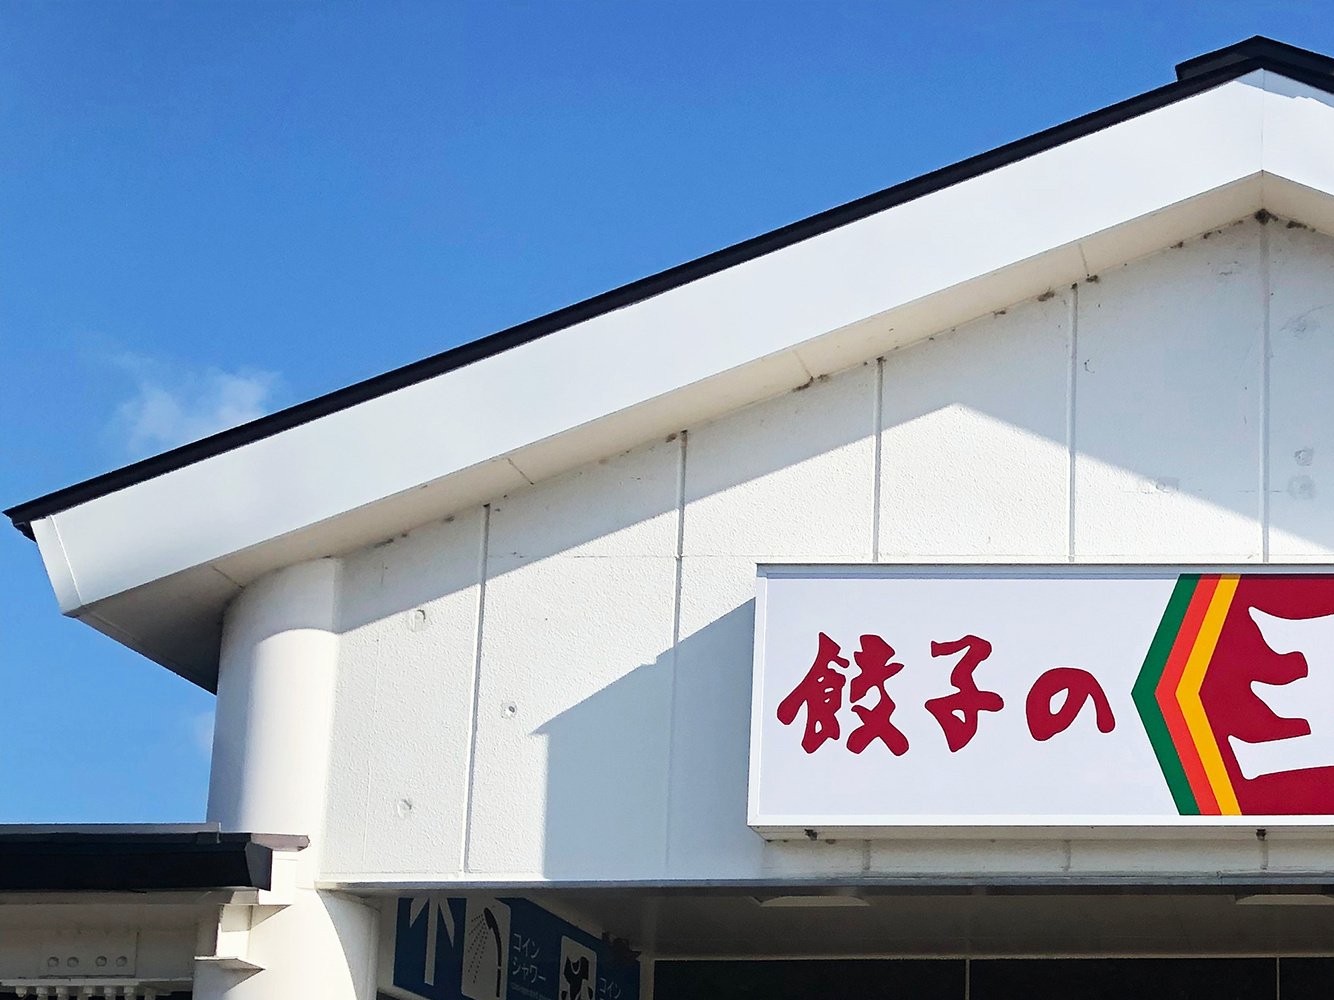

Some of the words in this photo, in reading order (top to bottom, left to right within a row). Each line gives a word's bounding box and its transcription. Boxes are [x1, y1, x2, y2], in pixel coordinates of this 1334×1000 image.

[777, 631, 1115, 756] 餃子の
[513, 932, 541, 959] コイン
[512, 957, 546, 983] シャワー
[599, 977, 622, 999] コイン
